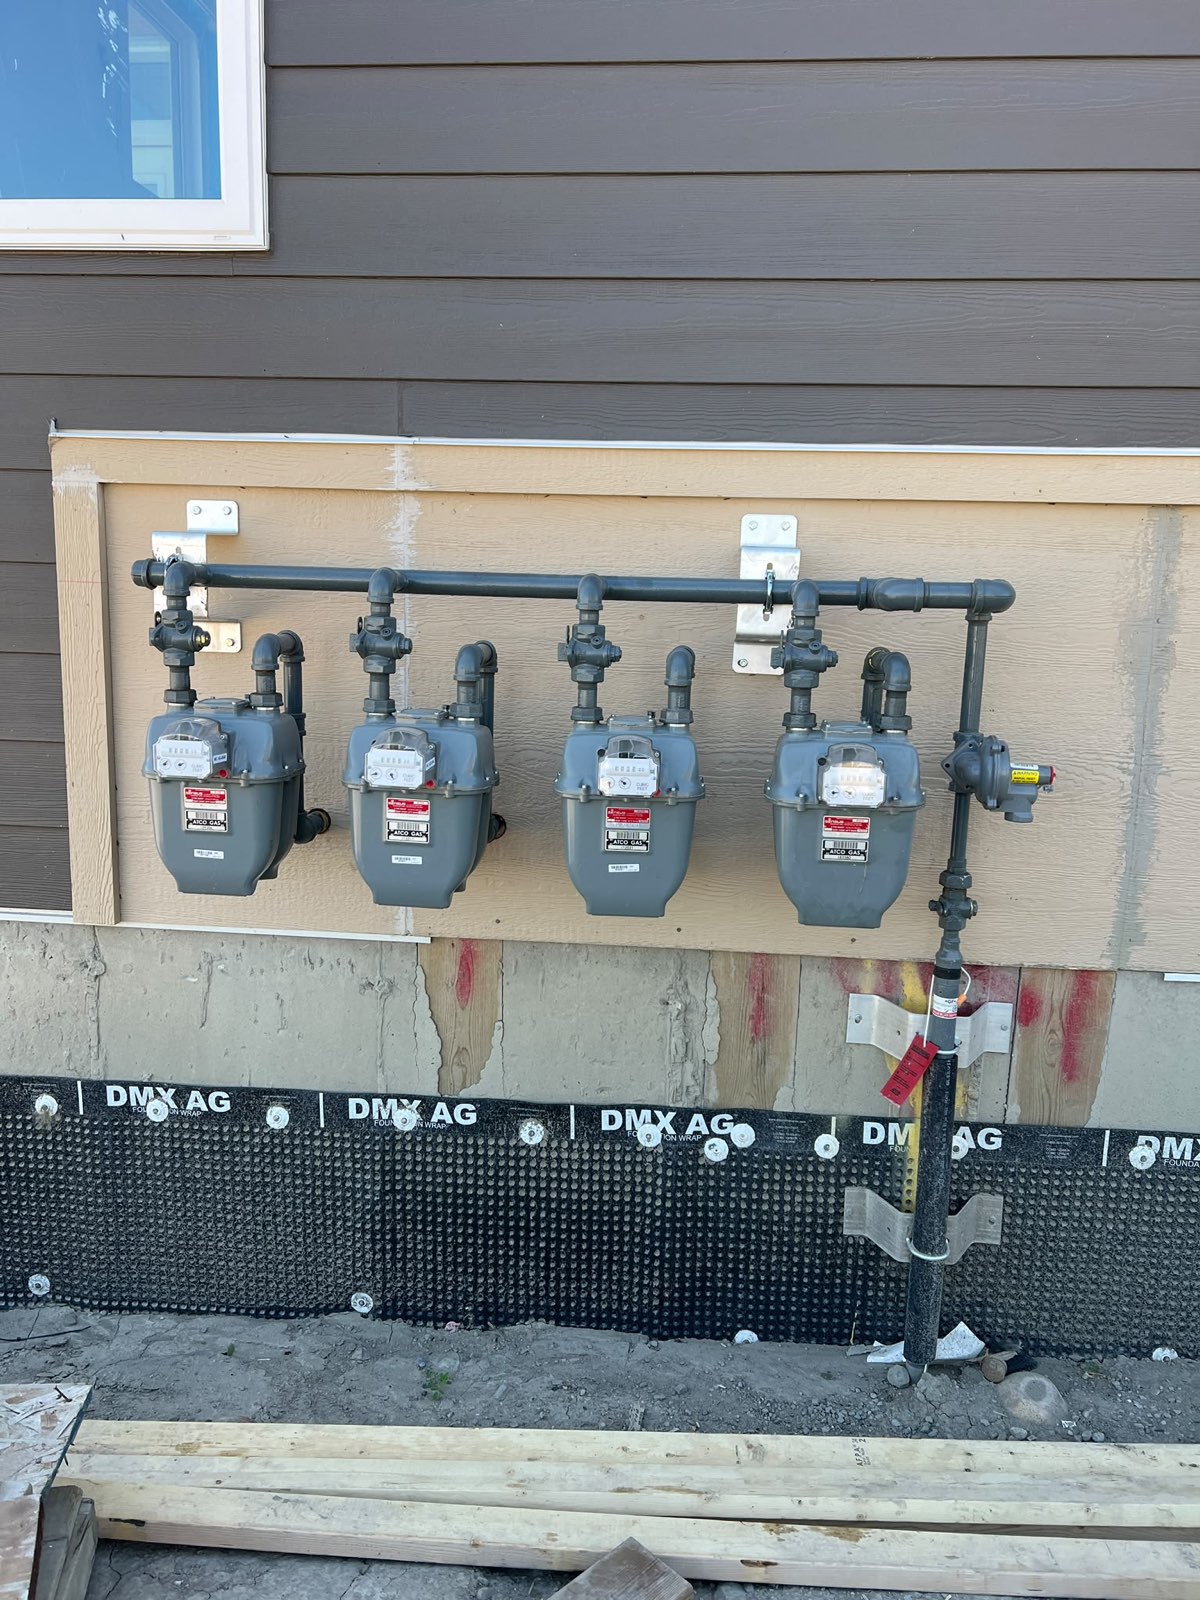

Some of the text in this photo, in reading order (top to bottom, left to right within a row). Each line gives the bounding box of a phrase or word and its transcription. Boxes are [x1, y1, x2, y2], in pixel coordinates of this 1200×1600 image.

[106, 1085, 231, 1113] DMX AG
[348, 1097, 477, 1125] DMX AG
[180, 1109, 202, 1117] WRAP
[424, 1121, 447, 1129] WRAP
[601, 1109, 734, 1135] DMX AG
[862, 1121, 915, 1146] DM
[954, 1126, 1003, 1151] AG
